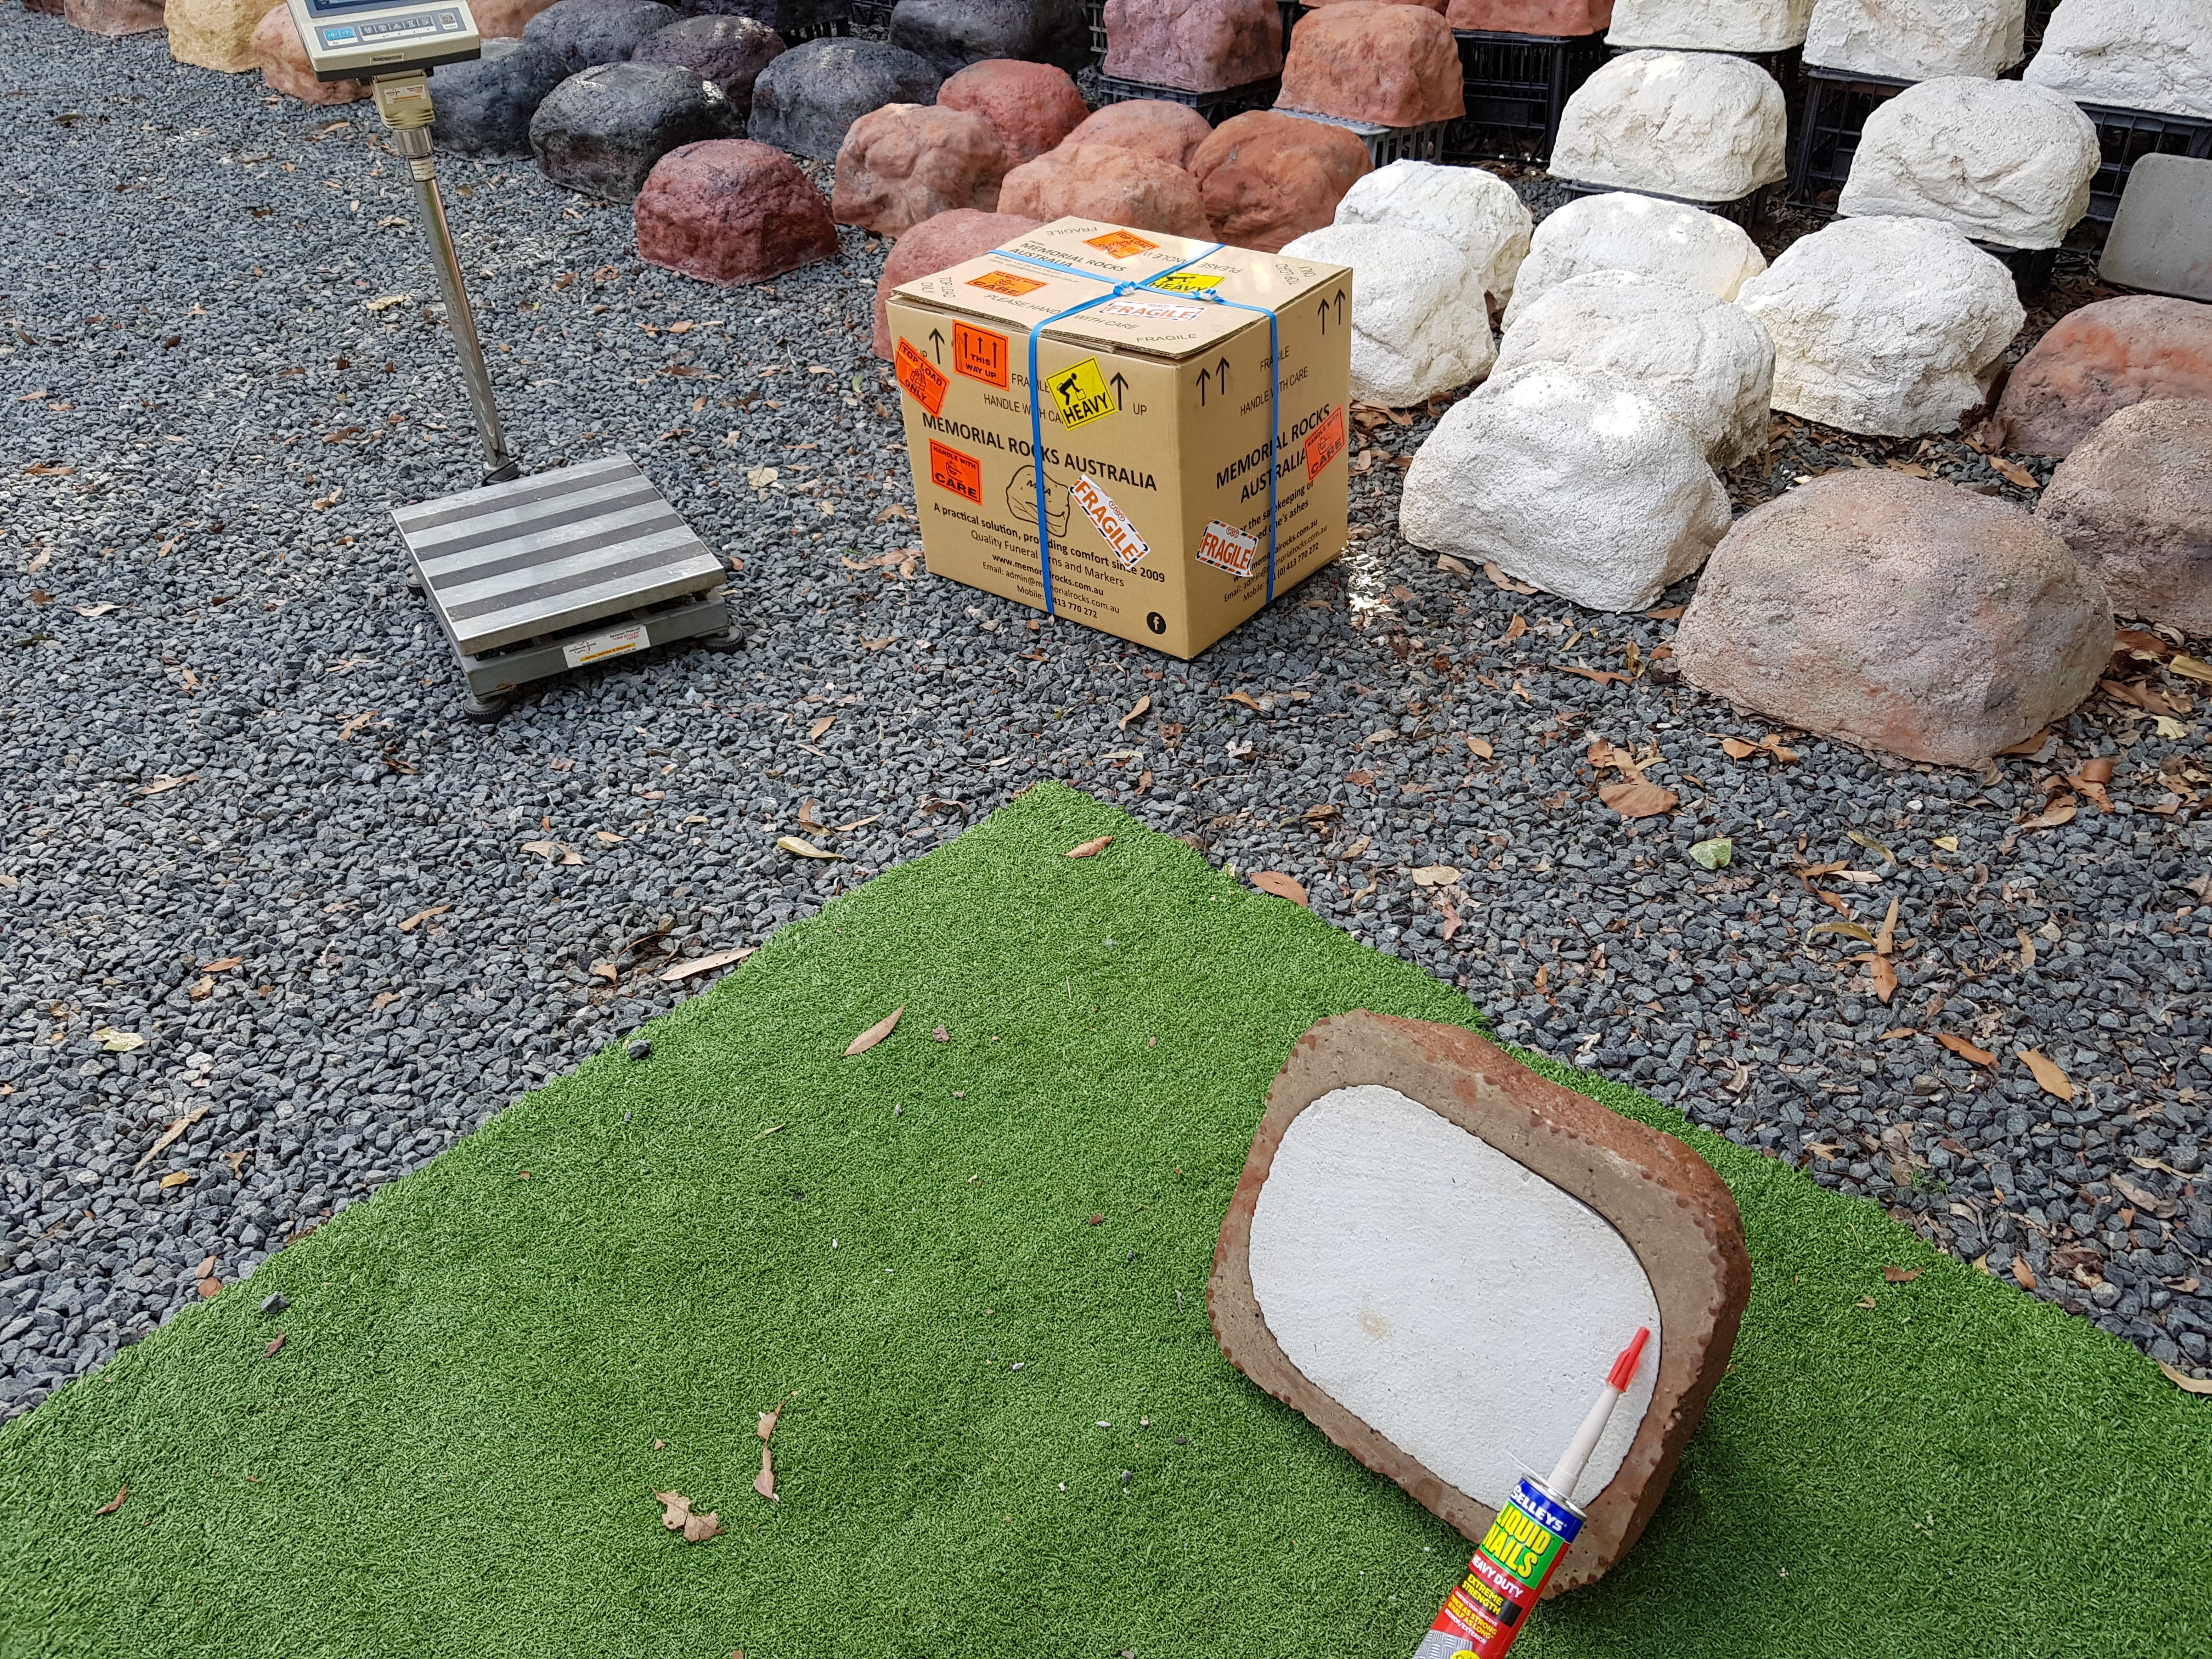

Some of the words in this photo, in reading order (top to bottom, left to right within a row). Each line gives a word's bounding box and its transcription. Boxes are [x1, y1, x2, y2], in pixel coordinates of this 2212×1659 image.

[1047, 227, 1097, 236] FRAGILE
[1131, 239, 1150, 248] LOAD
[1009, 249, 1072, 267] AUSTRALIA
[1020, 242, 1084, 263] MEMORIAL
[1086, 259, 1127, 272] ROCKS
[1098, 244, 1119, 253] ONLY
[1152, 253, 1192, 263] ANDLE
[1197, 262, 1243, 273] PLEASE
[1297, 266, 1316, 277] ONLY
[921, 282, 935, 294] ONLY
[973, 280, 1021, 296] CARE
[1149, 282, 1206, 292] HEAVY
[1284, 276, 1301, 285] TOP
[983, 294, 1028, 307] PLEASE
[1028, 304, 1062, 315] HAND
[1074, 314, 1105, 324] WITH
[1104, 321, 1140, 330] CARE
[1106, 305, 1195, 319] FRAGILE
[1137, 334, 1197, 342] FRAGILE
[902, 345, 918, 363] TOP
[920, 363, 943, 386] LOAD
[965, 363, 983, 374] WAY
[985, 370, 996, 379] UP
[970, 353, 991, 366] THIS
[1260, 346, 1289, 373] FRAILE
[905, 379, 927, 401] ONLY
[1012, 373, 1050, 393] FRAILE
[1240, 390, 1269, 416] HANDLE
[1290, 366, 1308, 386] CARE
[984, 393, 1020, 413] HANDLE
[1022, 403, 1046, 420] WH
[1063, 392, 1108, 424] HEAVY
[1133, 403, 1147, 415] UP
[1307, 427, 1327, 448] HANDLE
[1327, 412, 1339, 427] WITH
[922, 413, 1005, 450] MEMORIAL
[1064, 453, 1157, 492] AUSTRALIA
[933, 445, 958, 461] HANDLE
[960, 457, 976, 470] WITH
[1216, 431, 1288, 489] MEMORIAL
[1291, 404, 1330, 442] ROCKS
[1311, 437, 1342, 475] CARE
[935, 472, 978, 499] CARE
[1075, 481, 1139, 562] FRAGILE
[1249, 515, 1261, 529] the
[1289, 500, 1308, 518] ashes
[934, 503, 940, 512] A
[942, 506, 979, 525] practical
[981, 520, 1021, 540] solution,
[1023, 533, 1068, 555] proding
[1070, 548, 1109, 567] comfort
[1140, 567, 1165, 583] 2009
[1200, 533, 1251, 571] FRAGILE
[971, 529, 1002, 550] Quality
[1005, 540, 1039, 560] Funeral
[1048, 556, 1062, 567] rns
[1065, 561, 1082, 573] and
[1085, 566, 1124, 587] Markers
[992, 554, 1104, 596] www.memorlrocks.com.au
[1243, 583, 1265, 602] Mobile:
[1277, 566, 1285, 578] (0)
[1286, 558, 1297, 570] 413
[1298, 550, 1308, 563] 770
[1309, 542, 1319, 555] 272
[983, 561, 1004, 575] Email:
[1006, 570, 1119, 613] admin@mmorialrocks.com.au
[1224, 585, 1242, 602] Email:
[1017, 585, 1045, 600] Mobile:
[1068, 602, 1082, 613] 770
[1084, 608, 1098, 619] 272
[1510, 1485, 1564, 1532] SELLEYS
[1496, 1502, 1551, 1556] LIQUID
[1482, 1523, 1538, 1578] NAILS
[1468, 1573, 1504, 1606] EXTREME
[1471, 1554, 1497, 1578] HEAVY
[1493, 1573, 1523, 1598] DUTY
[1462, 1581, 1502, 1615] STRENGTH
[1450, 1594, 1464, 1610] TWICE
[1462, 1606, 1471, 1616] AS
[1470, 1613, 1497, 1635] STRONG
[1451, 1604, 1465, 1618] HALF
[1463, 1617, 1473, 1627] AS
